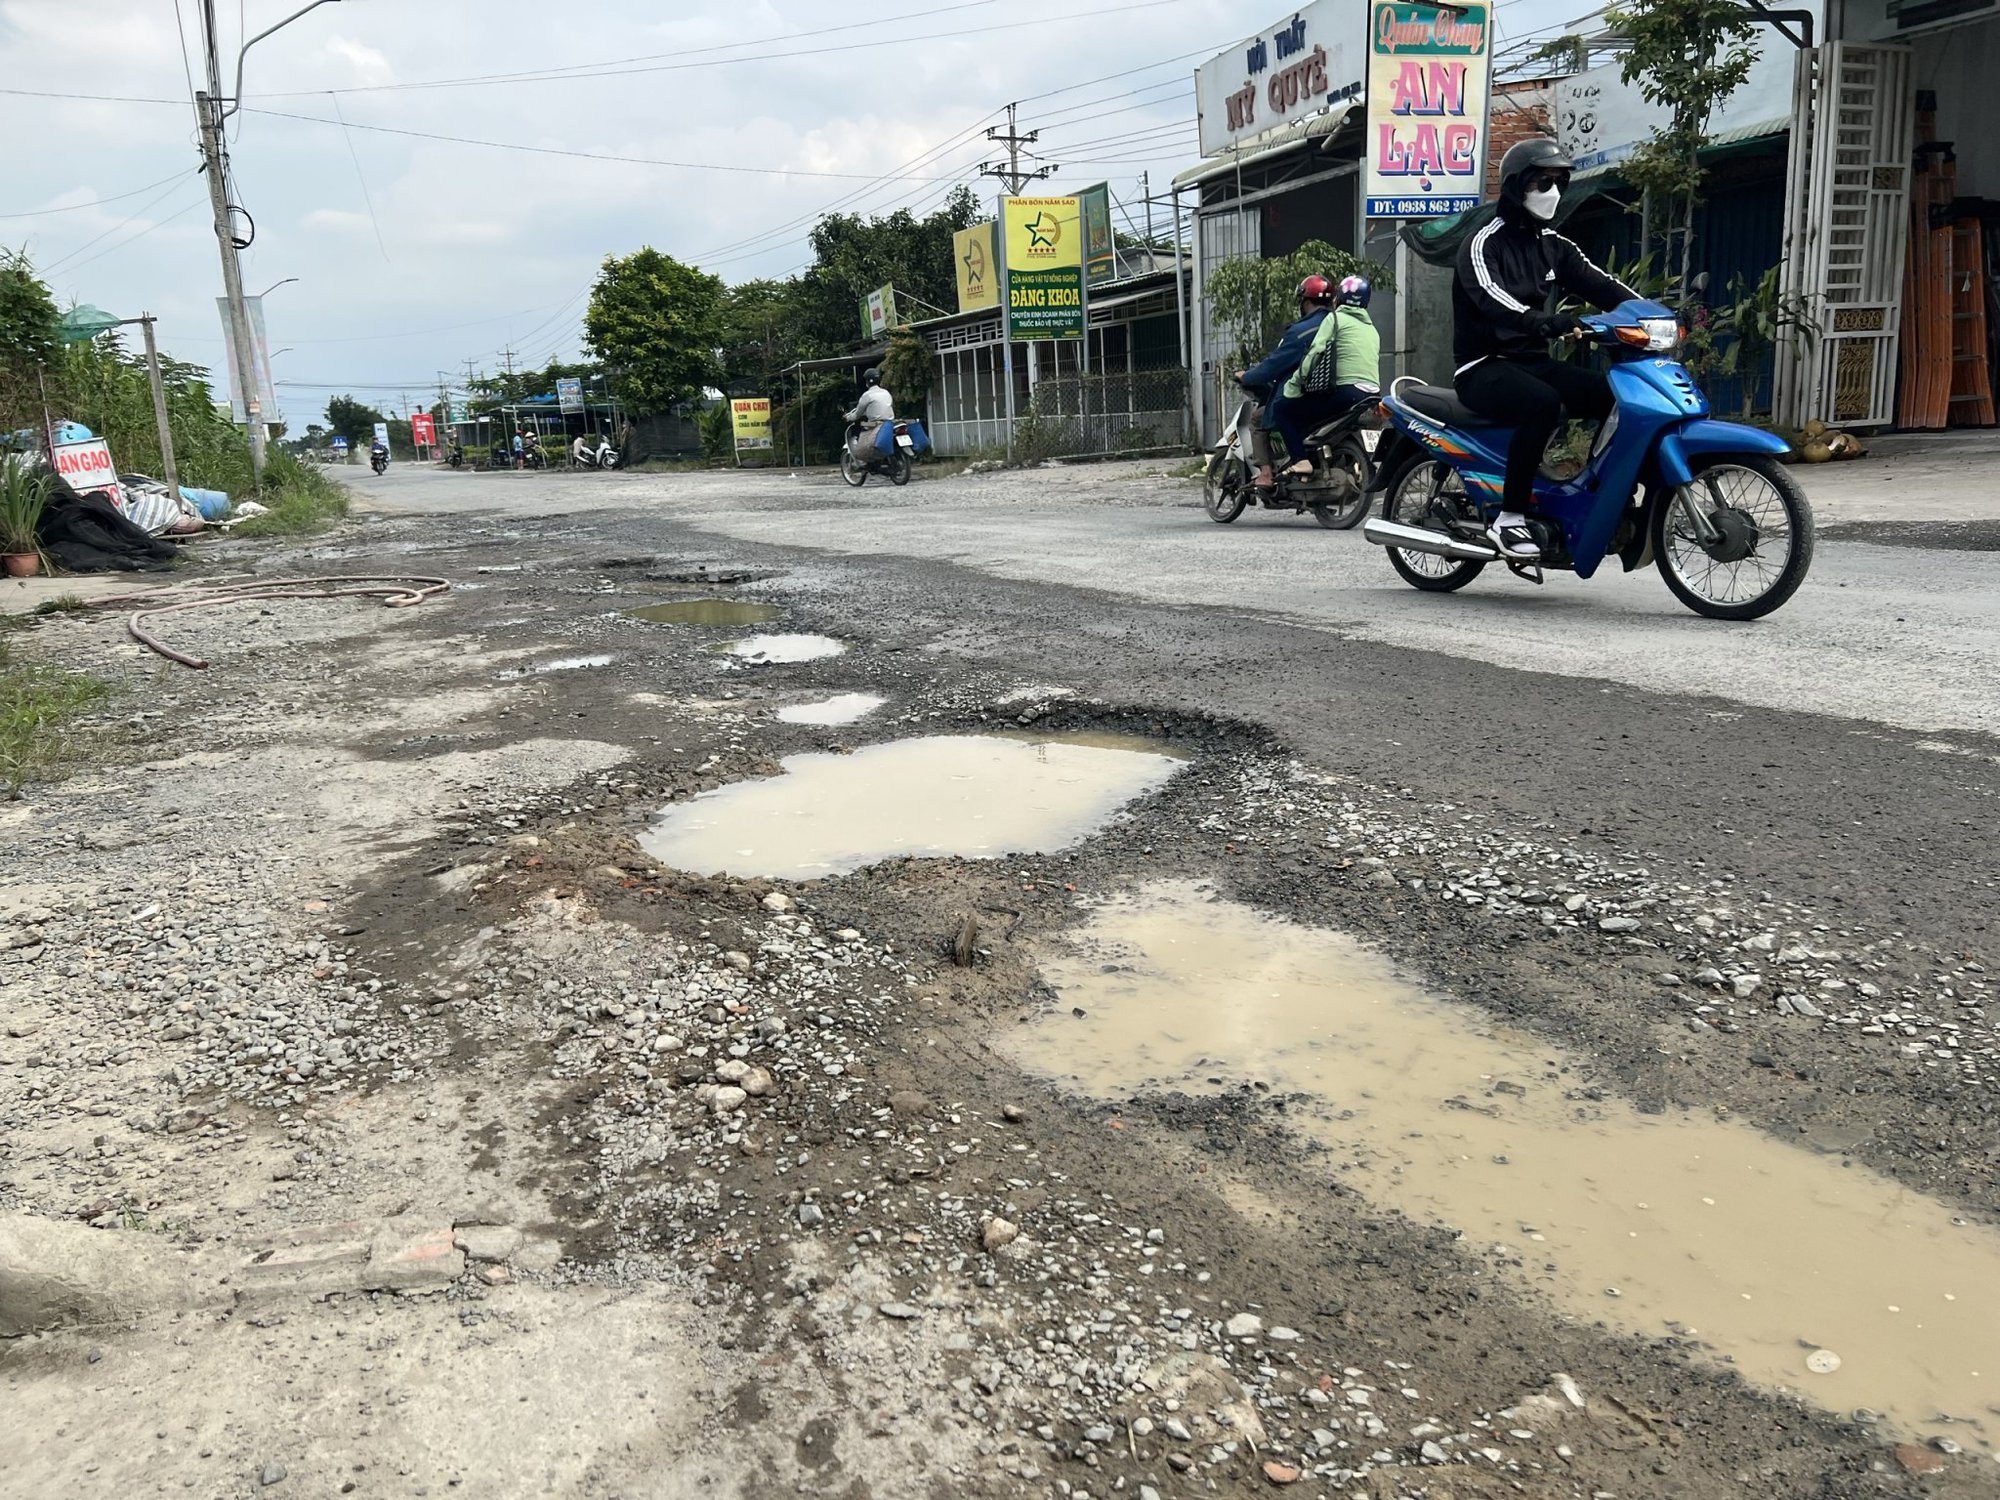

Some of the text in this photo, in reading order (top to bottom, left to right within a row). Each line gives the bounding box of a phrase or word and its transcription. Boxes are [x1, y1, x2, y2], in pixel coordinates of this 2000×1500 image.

[1274, 13, 1306, 60] THẤT
[1379, 6, 1483, 54] Quán Chay
[1376, 61, 1476, 192] AN LẠC
[1008, 198, 1027, 206] PHÂN
[1398, 200, 1426, 213] 0938
[1429, 200, 1450, 213] 862
[1011, 286, 1080, 306] ĐĂNG KHOA
[1011, 310, 1030, 319] CHUYÊN
[1407, 419, 1443, 440] Wave
